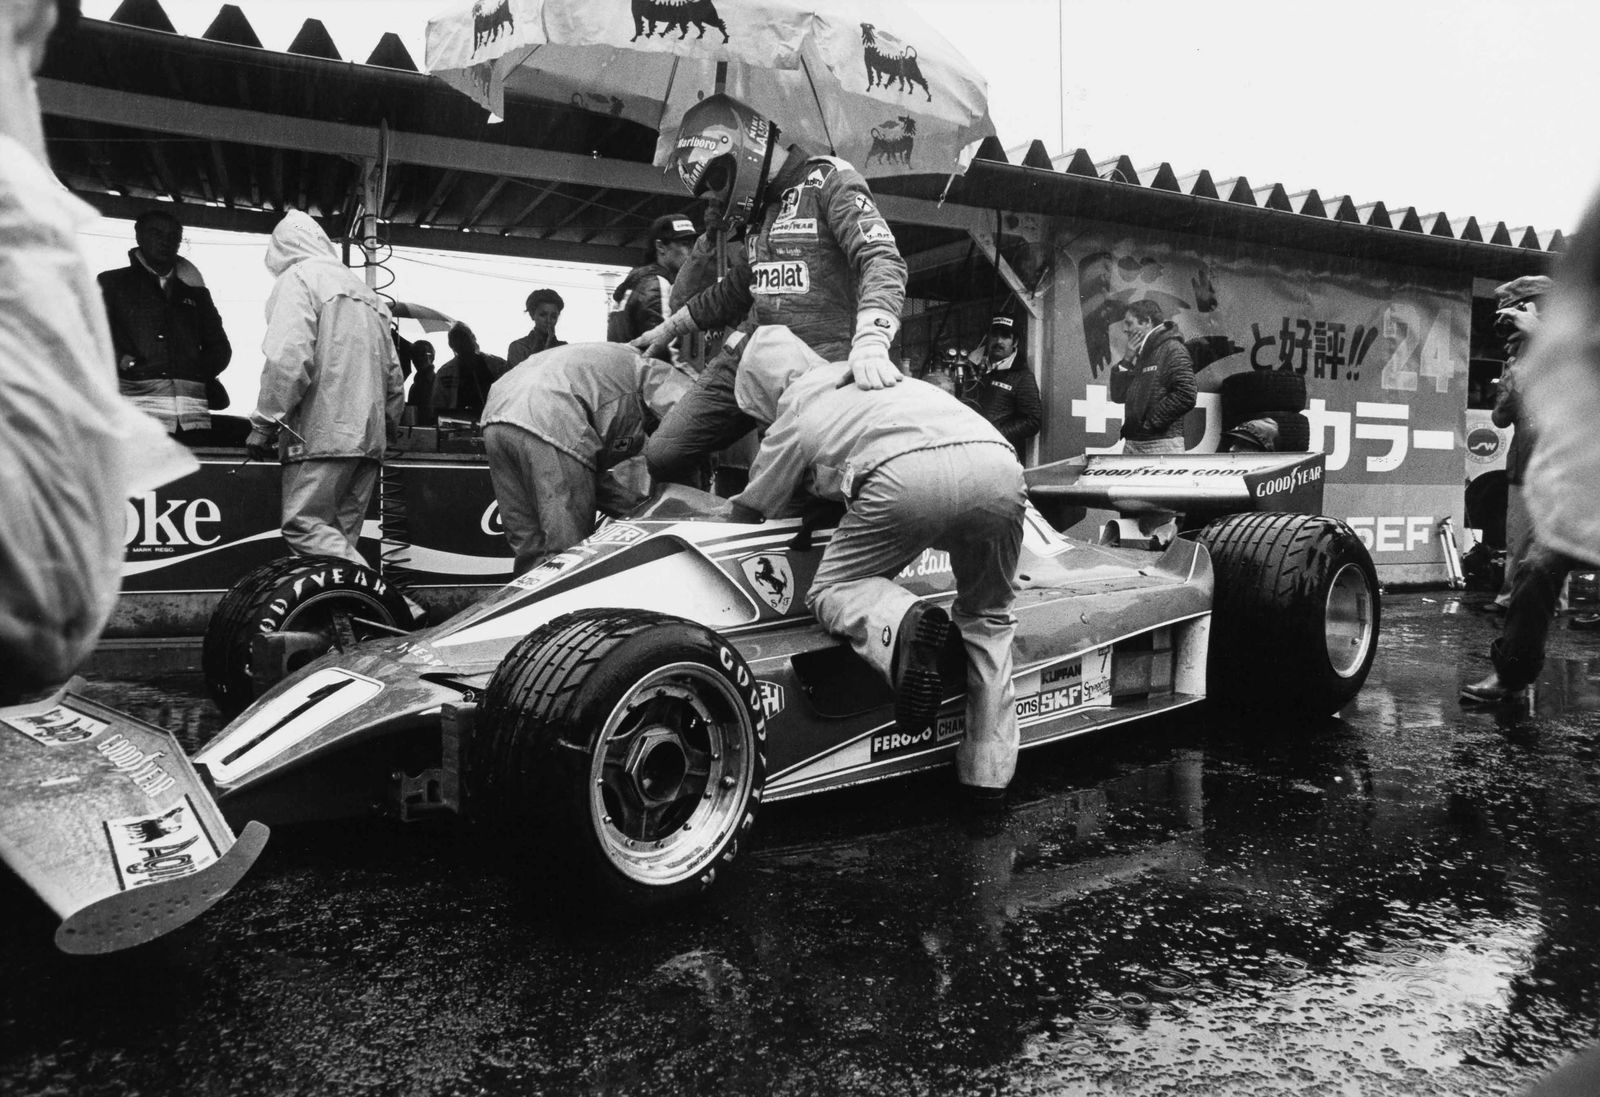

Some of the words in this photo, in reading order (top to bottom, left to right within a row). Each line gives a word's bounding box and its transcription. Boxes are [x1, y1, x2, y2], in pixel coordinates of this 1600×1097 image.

[677, 136, 716, 150] Marlboro
[1381, 303, 1454, 393] 24
[1016, 699, 1038, 716] ons
[1040, 685, 1082, 713] SKF
[220, 676, 357, 767] 1
